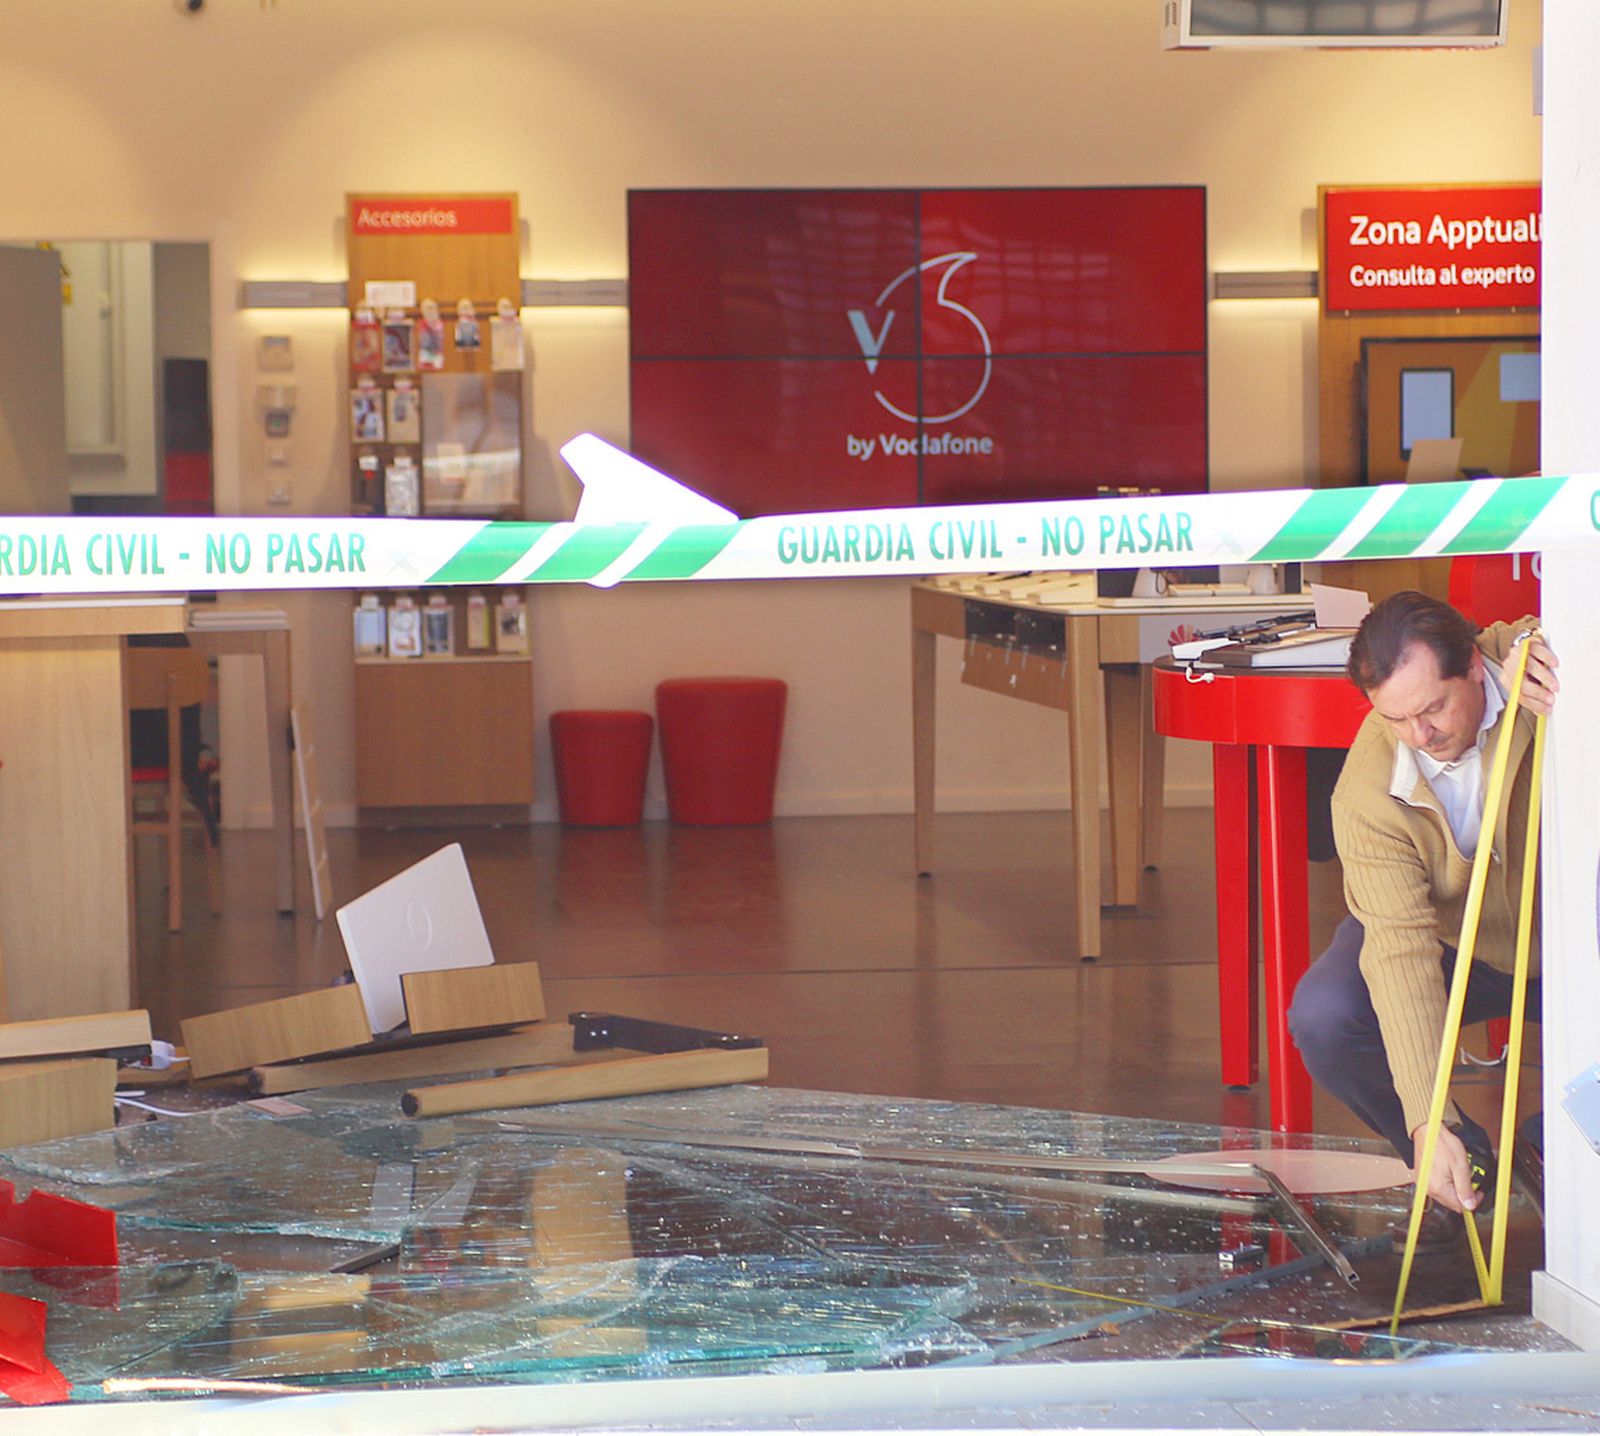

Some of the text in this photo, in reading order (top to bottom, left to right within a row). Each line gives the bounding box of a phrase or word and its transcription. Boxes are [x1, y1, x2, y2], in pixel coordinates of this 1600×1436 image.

[358, 207, 458, 228] Accesorios
[1349, 215, 1421, 245] Zona
[1349, 264, 1535, 288] Consulta al experto
[847, 432, 993, 461] by Vodafone
[777, 522, 915, 564] GUARDIA
[929, 520, 1003, 560] CIVIL
[1041, 515, 1085, 557] NO
[1099, 511, 1194, 554] PASAR
[86, 533, 165, 575] CIVIL
[206, 532, 251, 574] NO
[266, 532, 366, 573] PASAR
